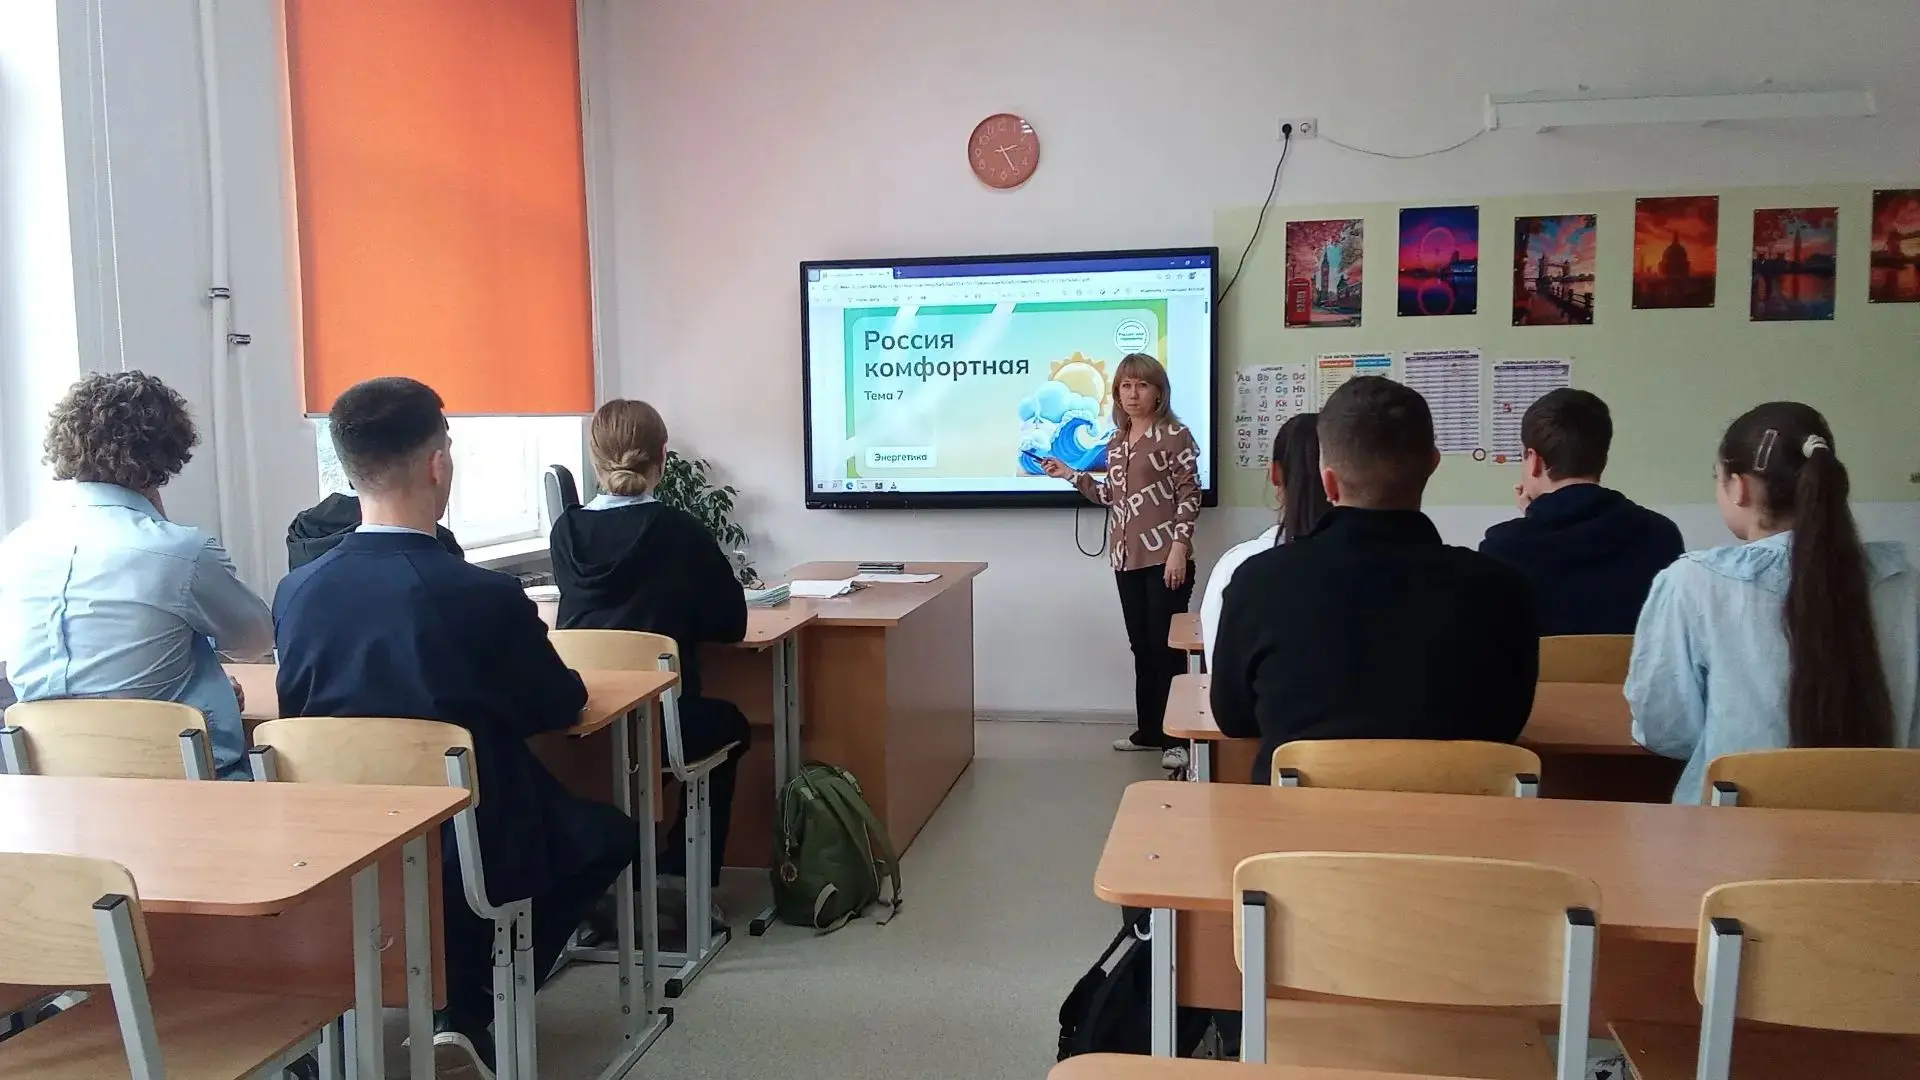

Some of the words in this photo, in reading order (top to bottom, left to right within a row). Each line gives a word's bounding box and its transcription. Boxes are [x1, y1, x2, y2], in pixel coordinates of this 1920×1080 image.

[864, 330, 954, 351] Россия
[865, 355, 1029, 382] комфортная
[1237, 373, 1251, 382] Aa
[1257, 373, 1269, 381] Bb
[1275, 386, 1288, 394] Gg
[1292, 385, 1305, 393] Hh
[864, 390, 893, 400] Тема
[897, 390, 904, 400] 7
[1275, 399, 1287, 407] Kk
[1236, 415, 1252, 423] Mm
[1238, 428, 1251, 437] Qq
[1257, 428, 1268, 436] Rr
[874, 453, 928, 463] Энергетика
